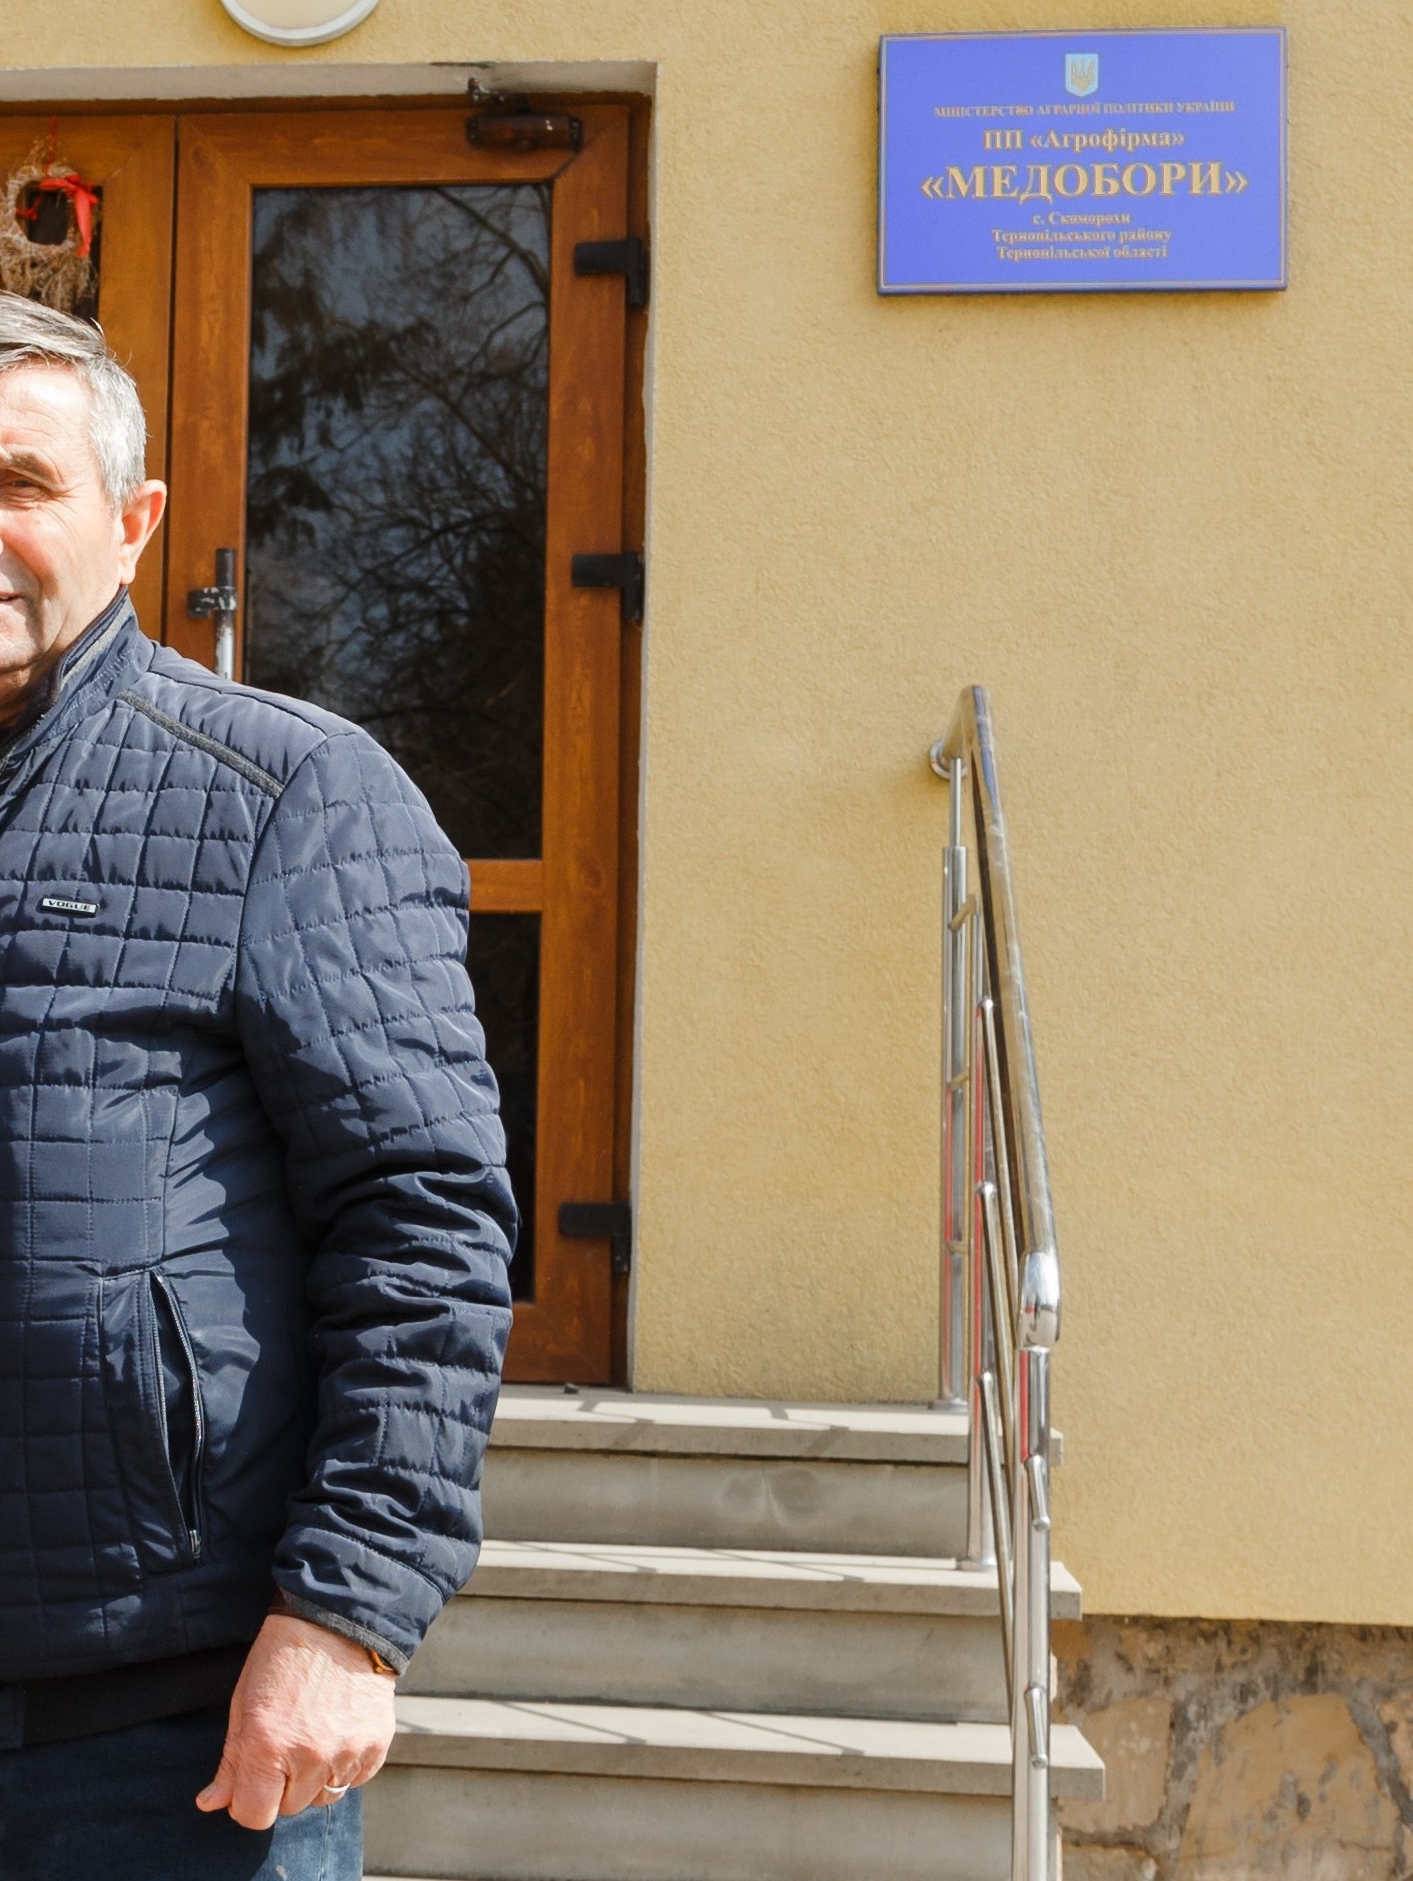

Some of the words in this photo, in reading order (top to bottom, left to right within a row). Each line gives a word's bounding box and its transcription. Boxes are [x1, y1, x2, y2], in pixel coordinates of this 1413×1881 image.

[1176, 99, 1235, 113] УКРАЇНИ
[983, 130, 1023, 150] ПП
[1030, 127, 1185, 152] «Агрофірма»
[921, 161, 1249, 204] «МЕДОБОРИ»
[1119, 228, 1172, 245] району
[1113, 243, 1168, 259] області
